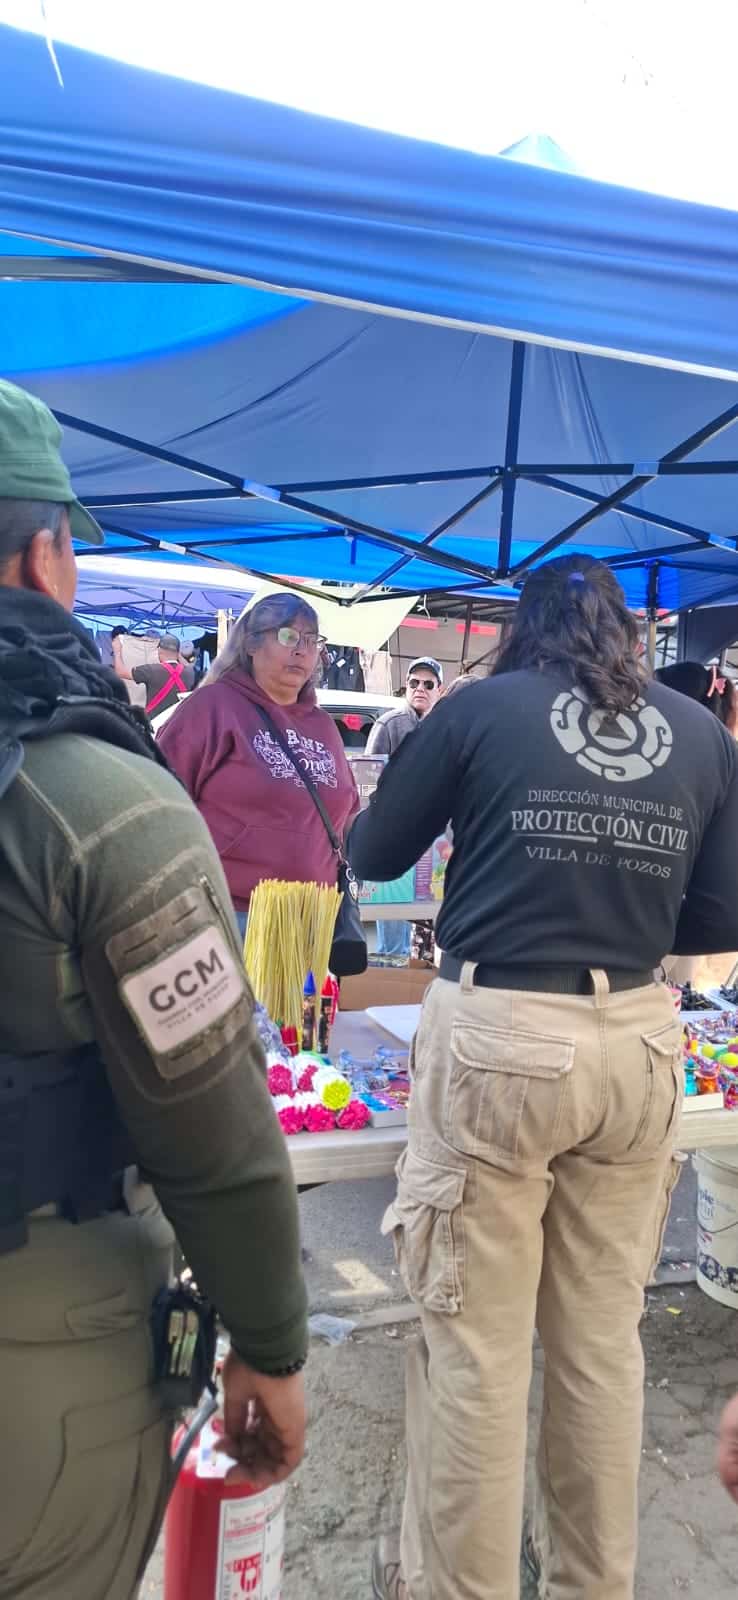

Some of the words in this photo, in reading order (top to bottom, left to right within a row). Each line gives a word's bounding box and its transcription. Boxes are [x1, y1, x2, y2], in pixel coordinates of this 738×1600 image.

[527, 790, 599, 806] DIRECCIÓN
[602, 795, 666, 816] MUNICIPAL
[668, 806, 683, 820] DE
[512, 809, 644, 841] PROTECCIÓN
[647, 823, 688, 850] CIVIL
[525, 846, 578, 862] VILLA
[585, 851, 610, 866] DE
[617, 855, 672, 878] POZOS
[149, 947, 224, 1012] GCM
